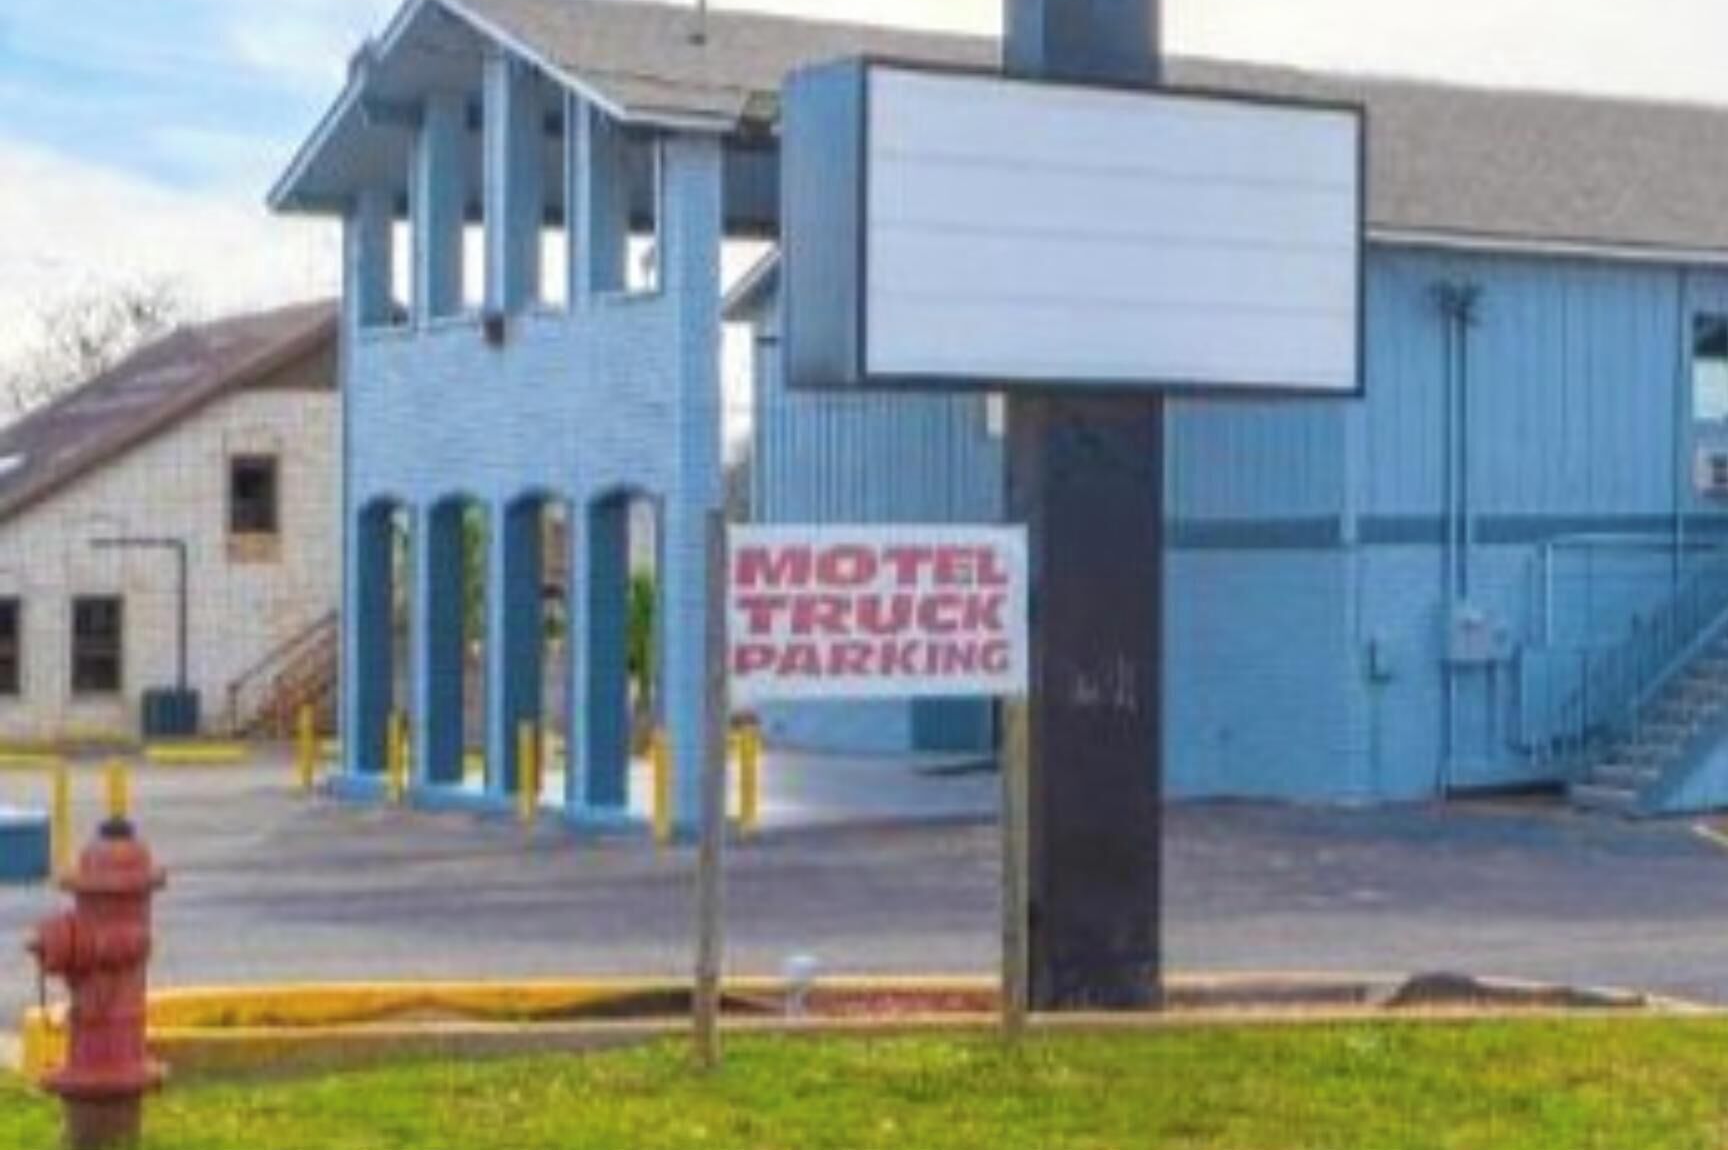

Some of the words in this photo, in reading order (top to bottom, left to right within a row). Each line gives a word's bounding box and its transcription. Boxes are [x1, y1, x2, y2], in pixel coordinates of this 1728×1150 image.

[734, 544, 1008, 586] MOTEL
[735, 592, 1004, 635] TRUCK
[734, 640, 1008, 677] PARKING
